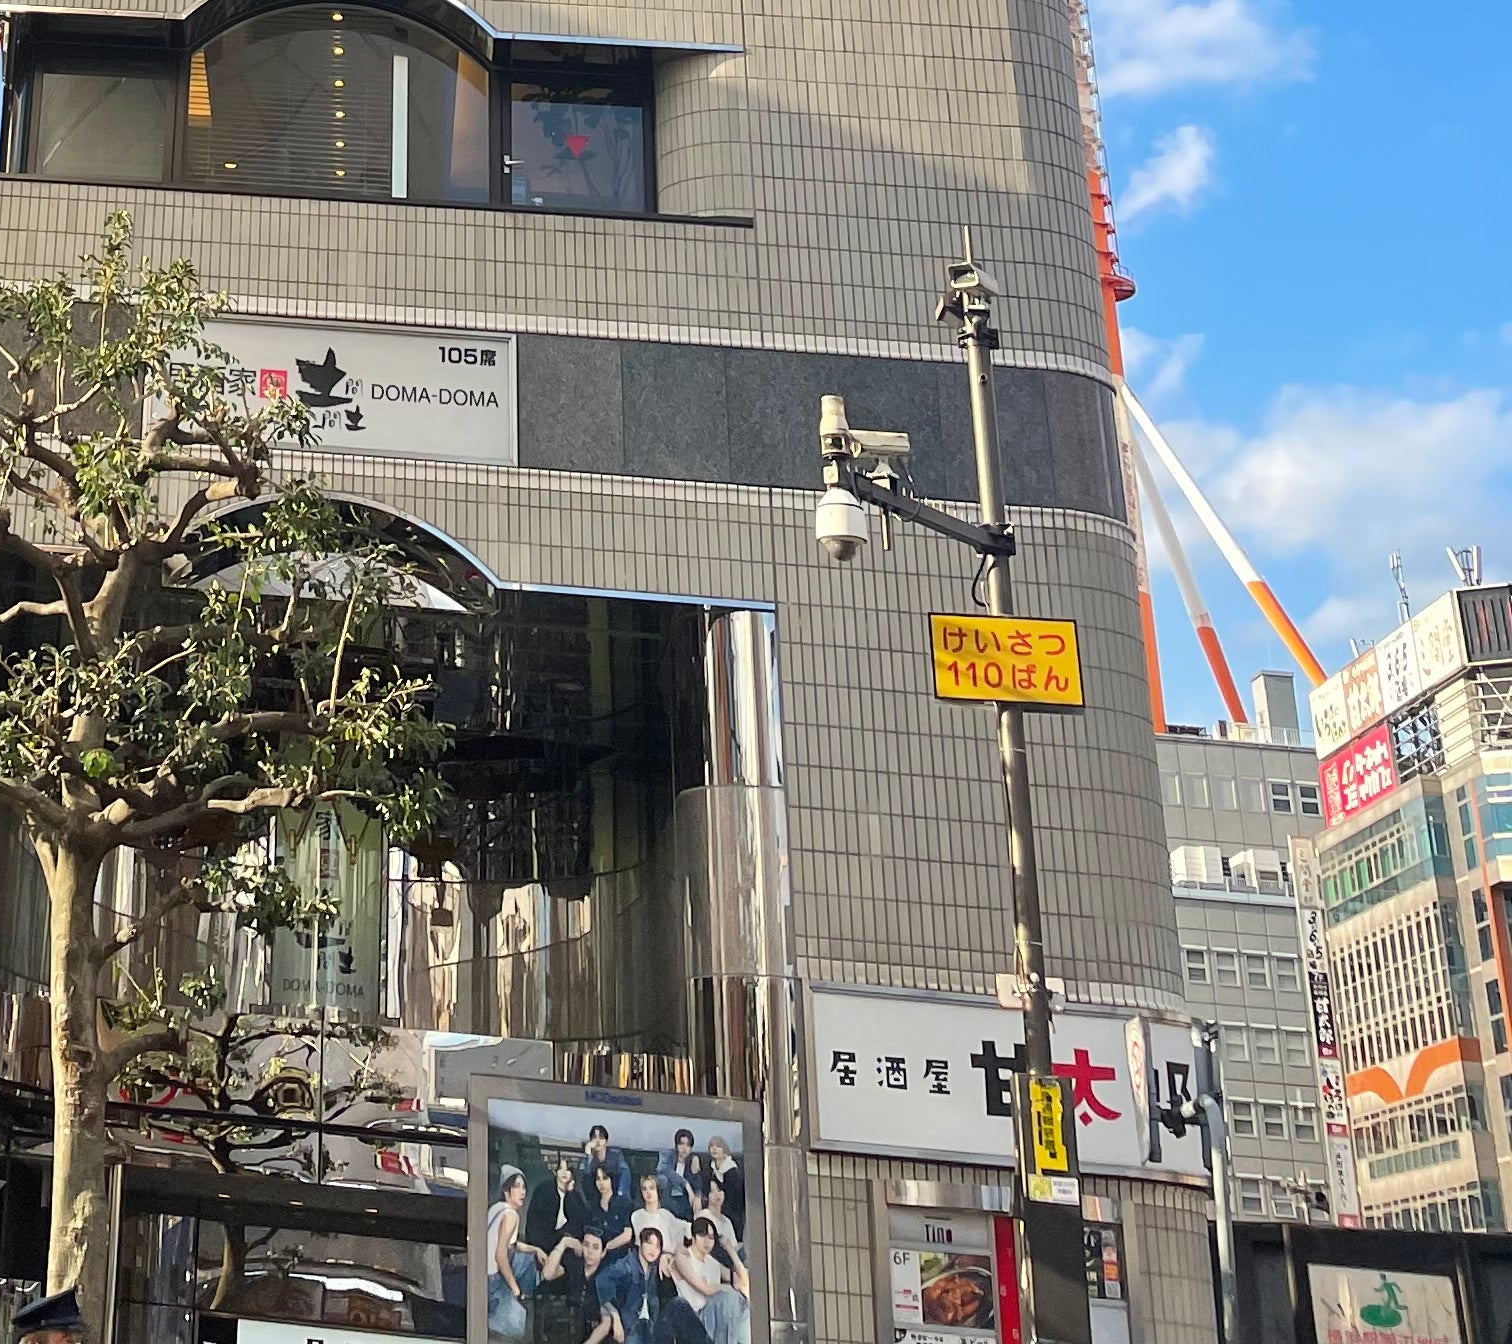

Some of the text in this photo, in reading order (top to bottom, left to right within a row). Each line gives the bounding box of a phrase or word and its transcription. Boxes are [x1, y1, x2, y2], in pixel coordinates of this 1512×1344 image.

[370, 383, 500, 409] DOMA-DOMA
[942, 625, 1066, 656] けいさつ
[830, 1050, 952, 1096] 居酒屋
[893, 1251, 911, 1266] 6F
